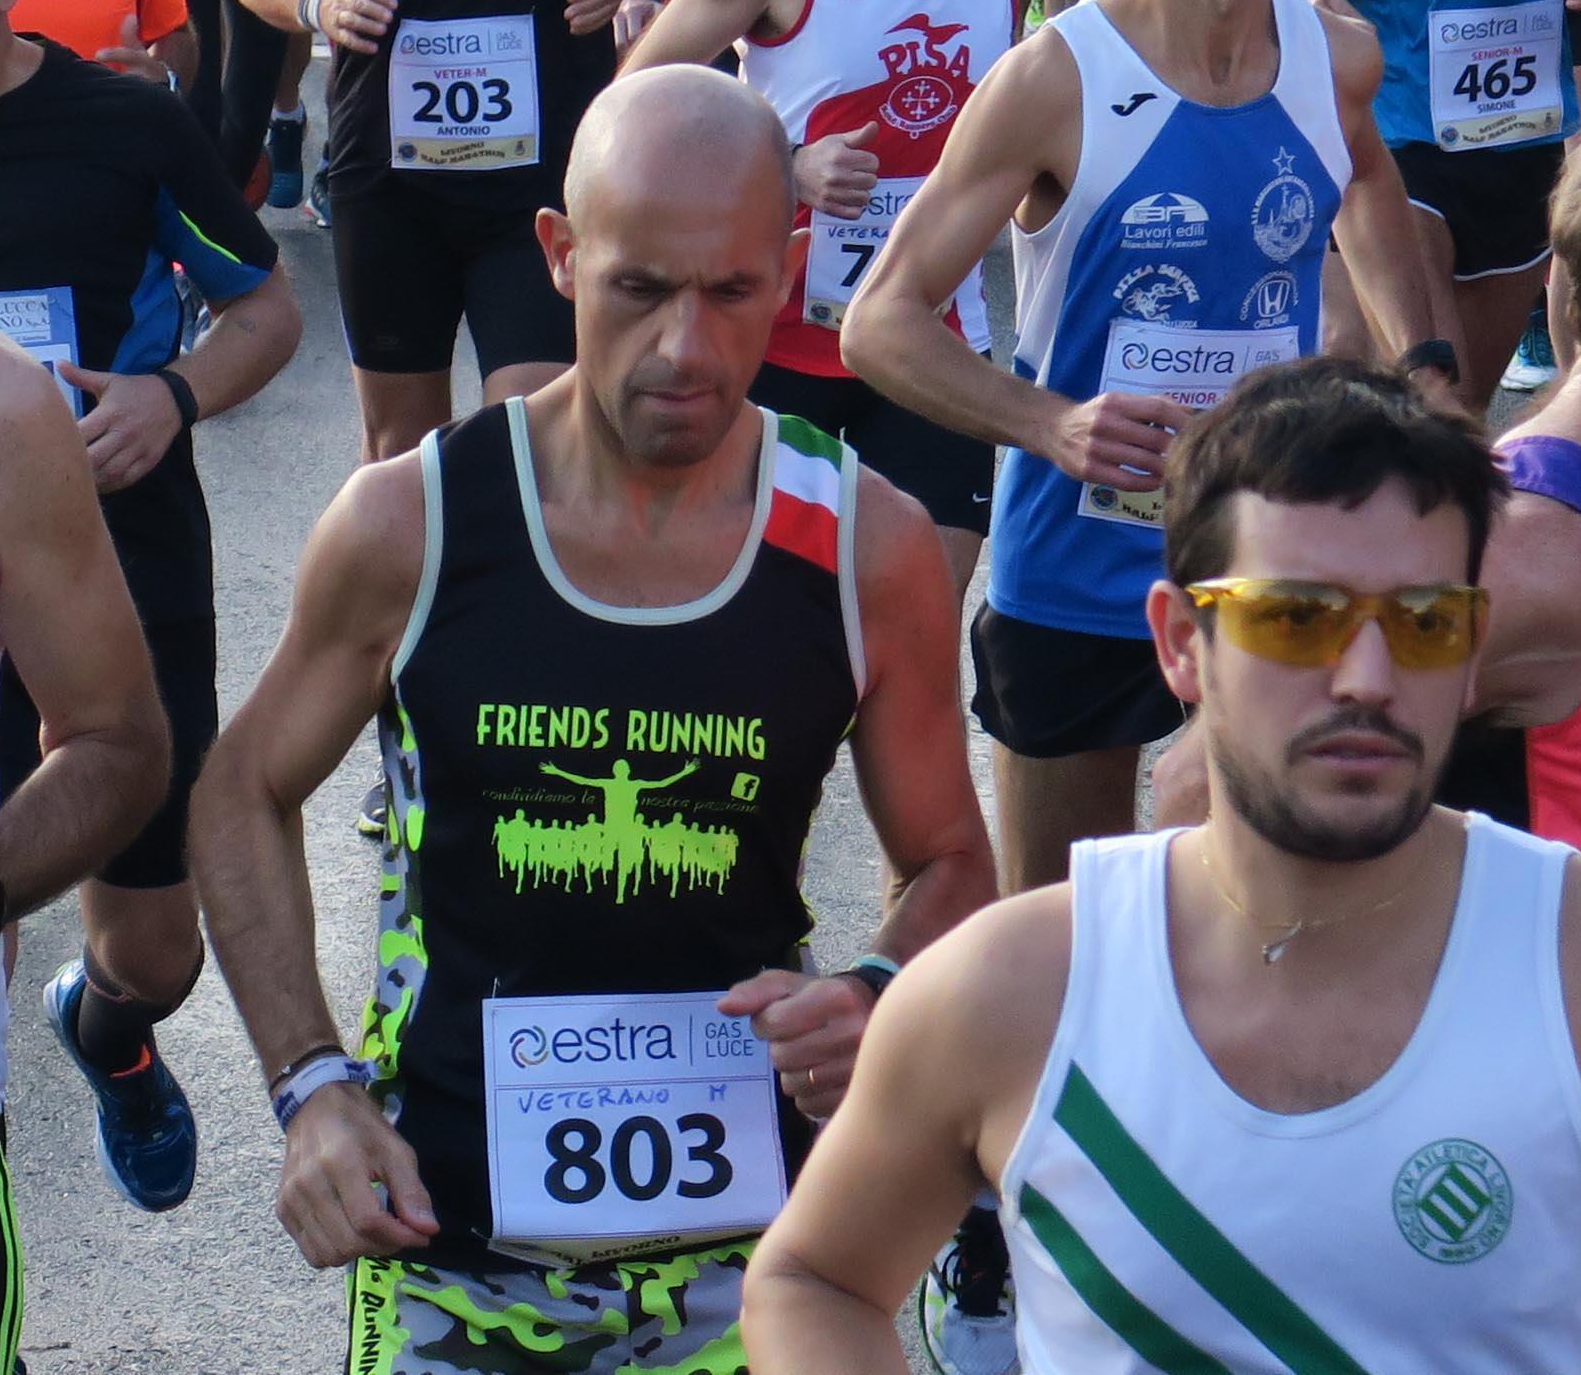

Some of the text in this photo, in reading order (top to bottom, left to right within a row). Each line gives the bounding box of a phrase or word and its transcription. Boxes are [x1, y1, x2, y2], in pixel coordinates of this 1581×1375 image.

[1461, 15, 1518, 42] estra
[415, 33, 482, 56] estra
[878, 37, 971, 78] PISA
[1472, 47, 1523, 62] SENIOR-M
[434, 67, 487, 80] VETER-M
[1453, 55, 1537, 104] 465
[411, 78, 513, 125] 203
[1477, 100, 1516, 115] SIMONE
[437, 125, 491, 137] ANTONIO
[1124, 223, 1205, 239] Lavori edili
[839, 244, 875, 289] 7
[1150, 344, 1235, 375] estra
[476, 703, 766, 761] FRIENDS RUNNING
[551, 1017, 677, 1064] estra
[705, 1021, 742, 1040] GAS
[705, 1039, 755, 1058] LUCE
[519, 1084, 727, 1114] VETERANO M
[543, 1112, 734, 1205] 803
[591, 1235, 681, 1257] LIVORNO
